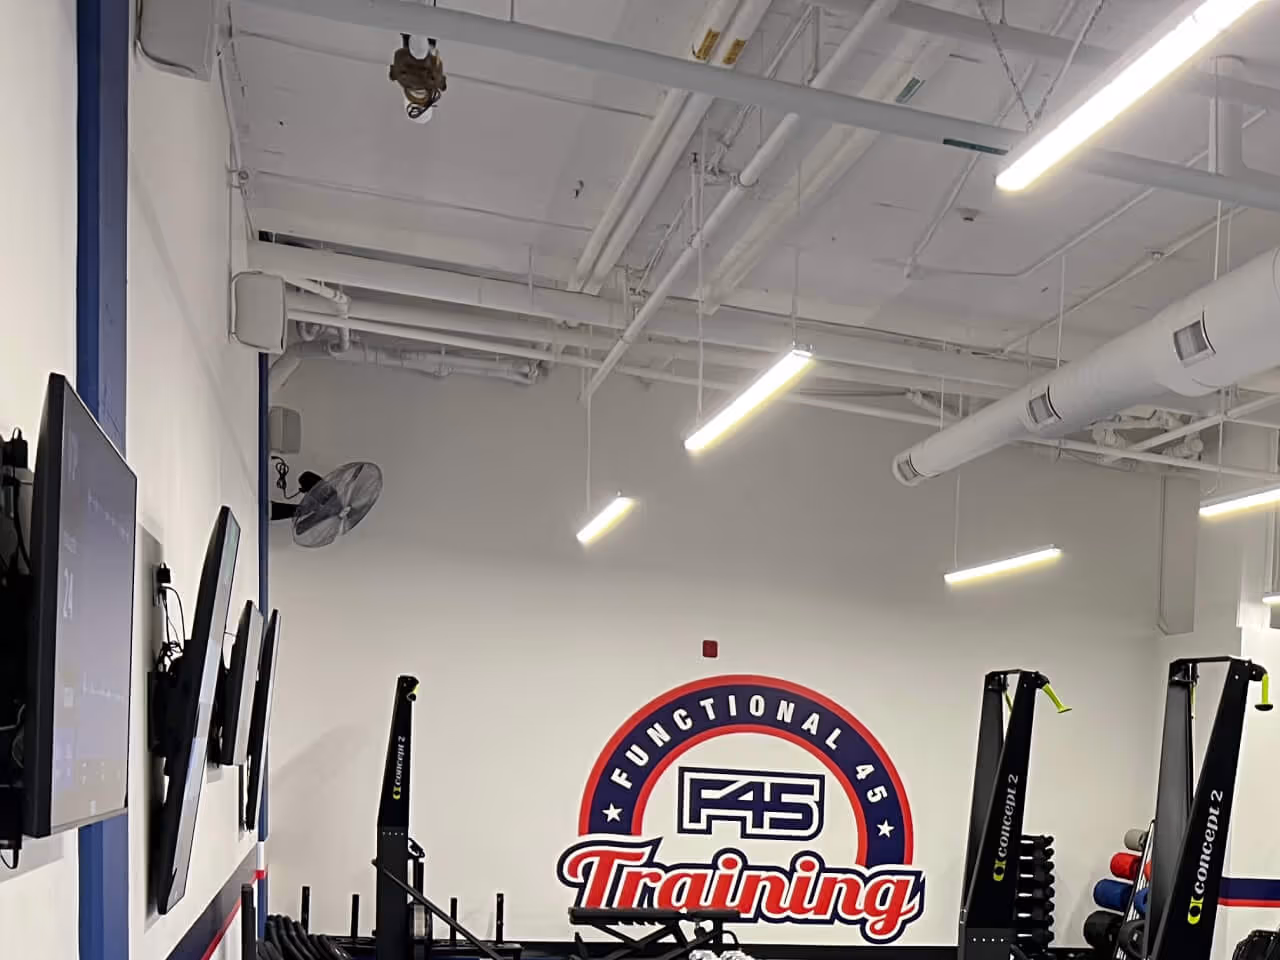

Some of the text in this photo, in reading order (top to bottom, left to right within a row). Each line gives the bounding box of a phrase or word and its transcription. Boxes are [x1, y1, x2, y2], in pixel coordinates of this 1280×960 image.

[610, 694, 888, 803] FUNCTIONAL 45
[678, 767, 825, 841] F45
[998, 774, 1019, 858] concept 2
[1194, 789, 1223, 895] concept 2
[559, 838, 924, 943] Training
